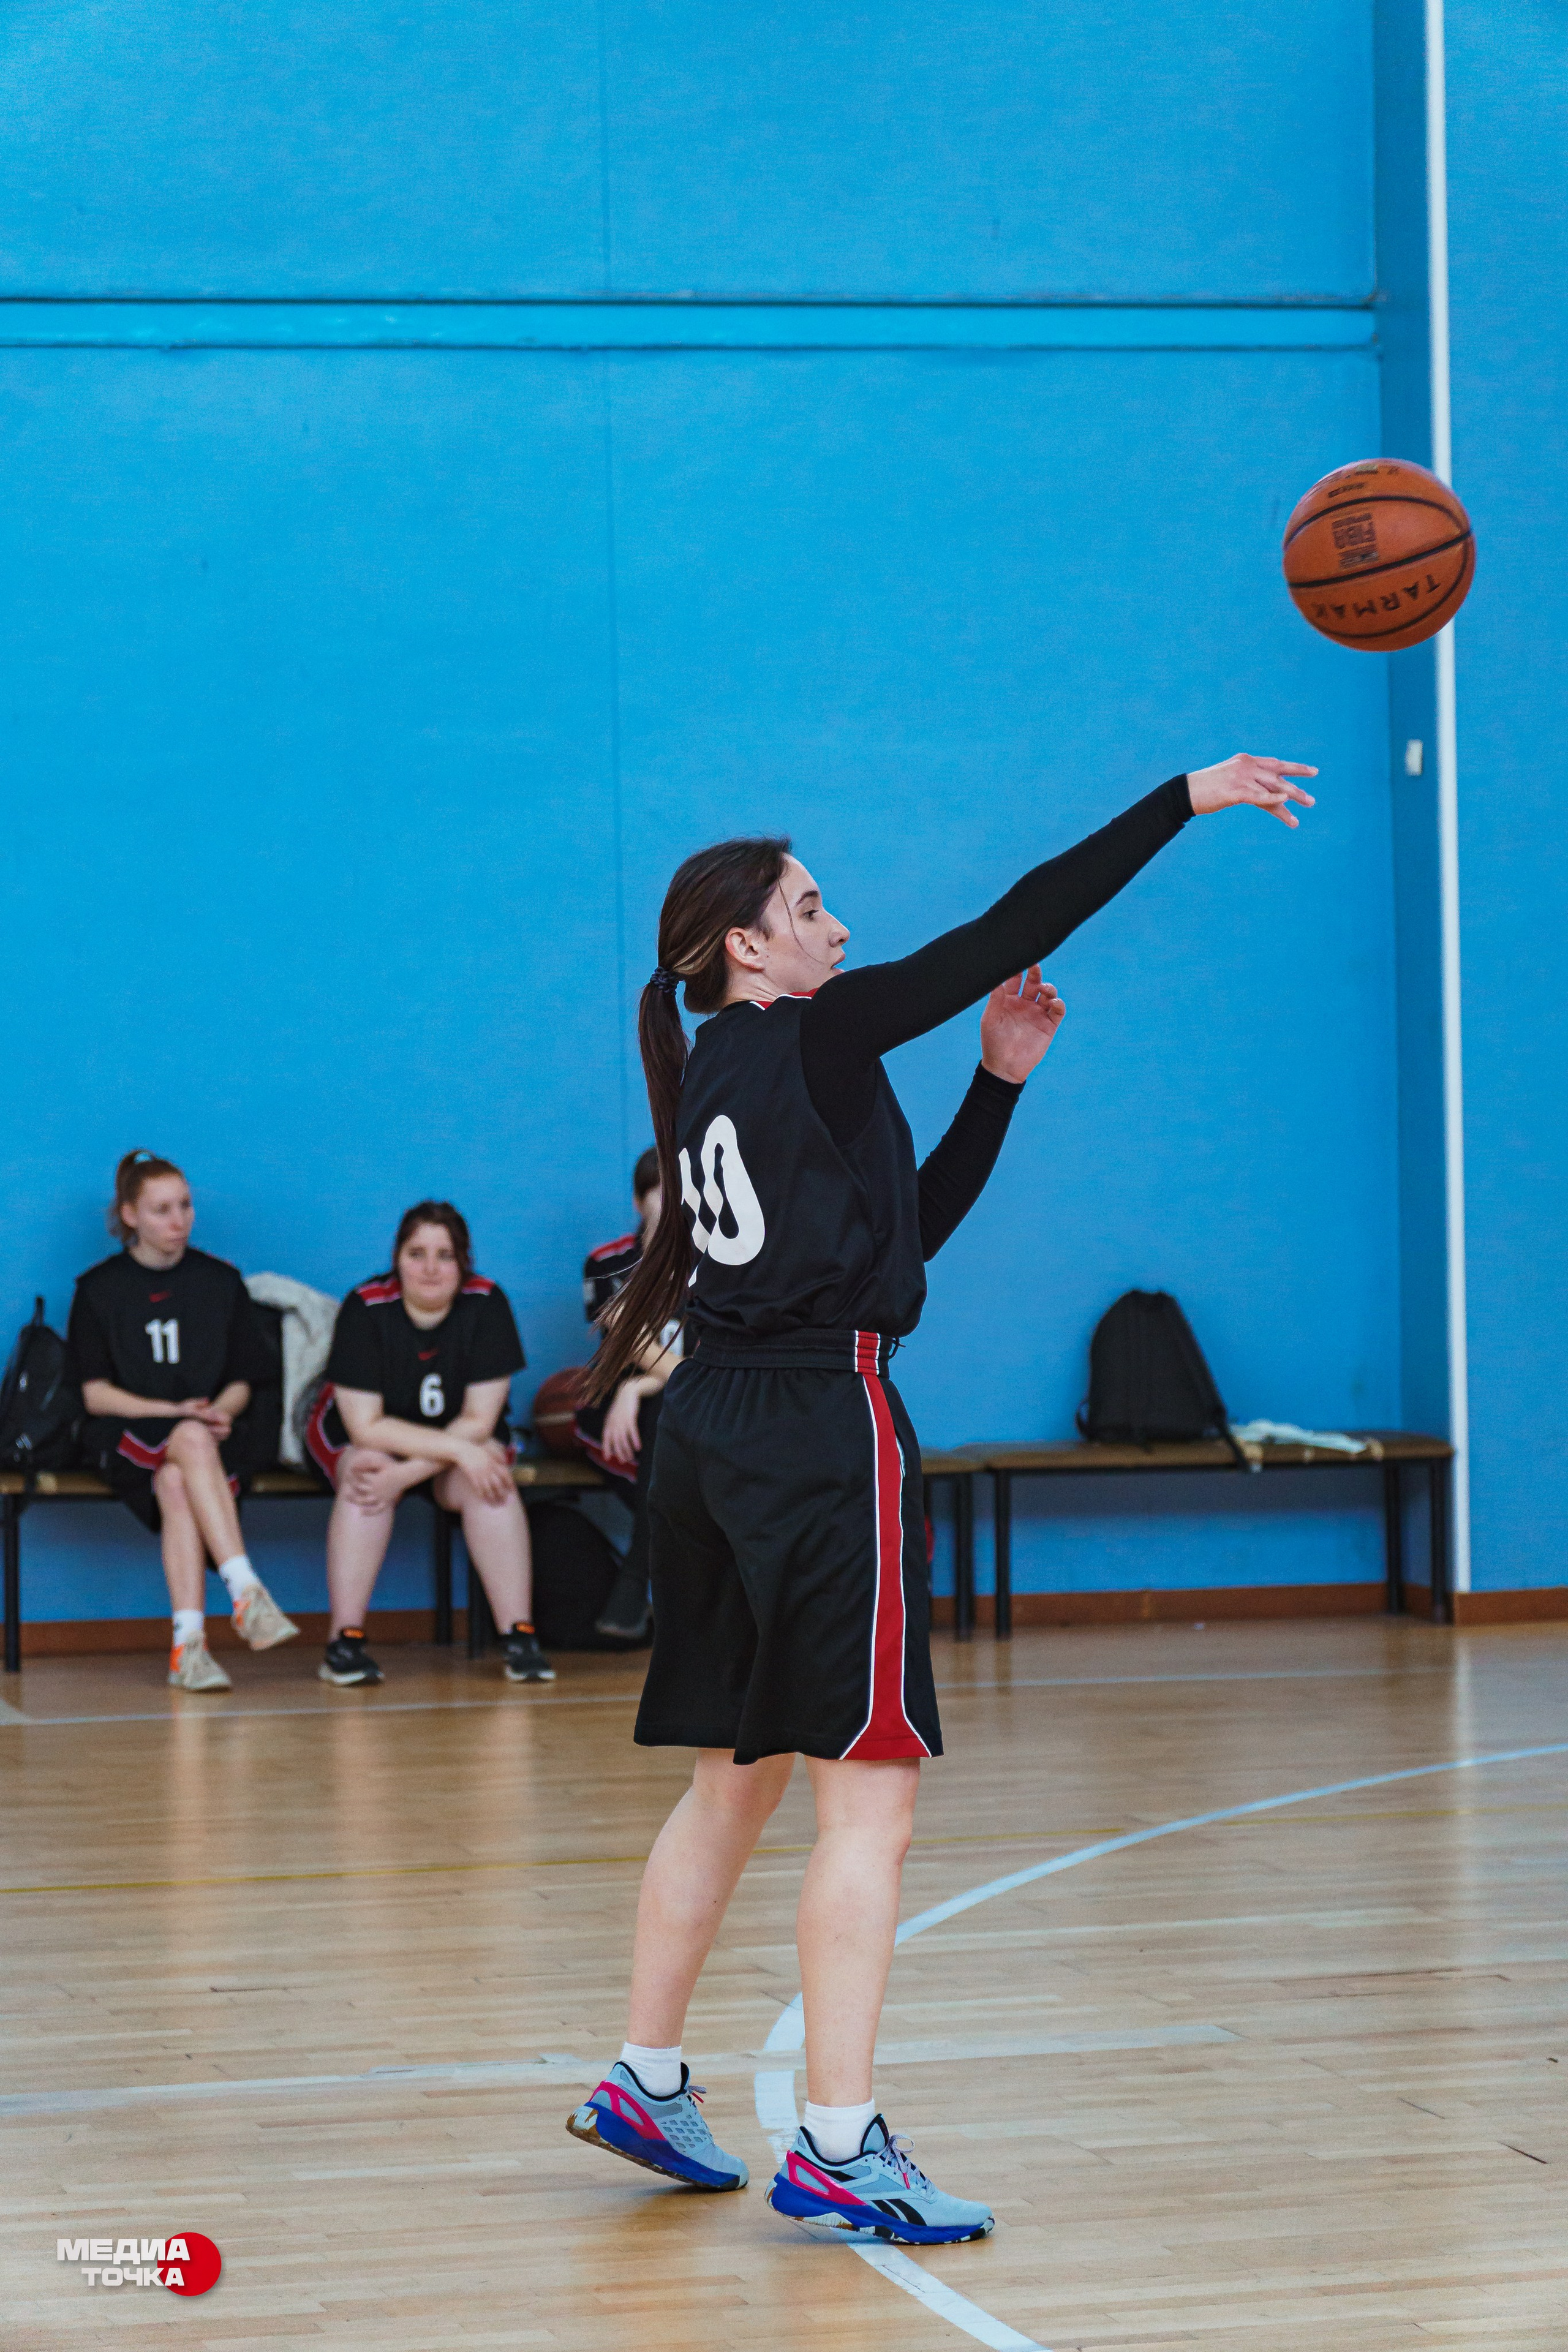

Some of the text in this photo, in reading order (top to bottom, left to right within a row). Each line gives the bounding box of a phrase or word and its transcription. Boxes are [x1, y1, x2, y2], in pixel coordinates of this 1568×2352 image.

[1311, 574, 1441, 619] TARMAK
[145, 1318, 180, 1365] 11
[420, 1373, 445, 1418] 6
